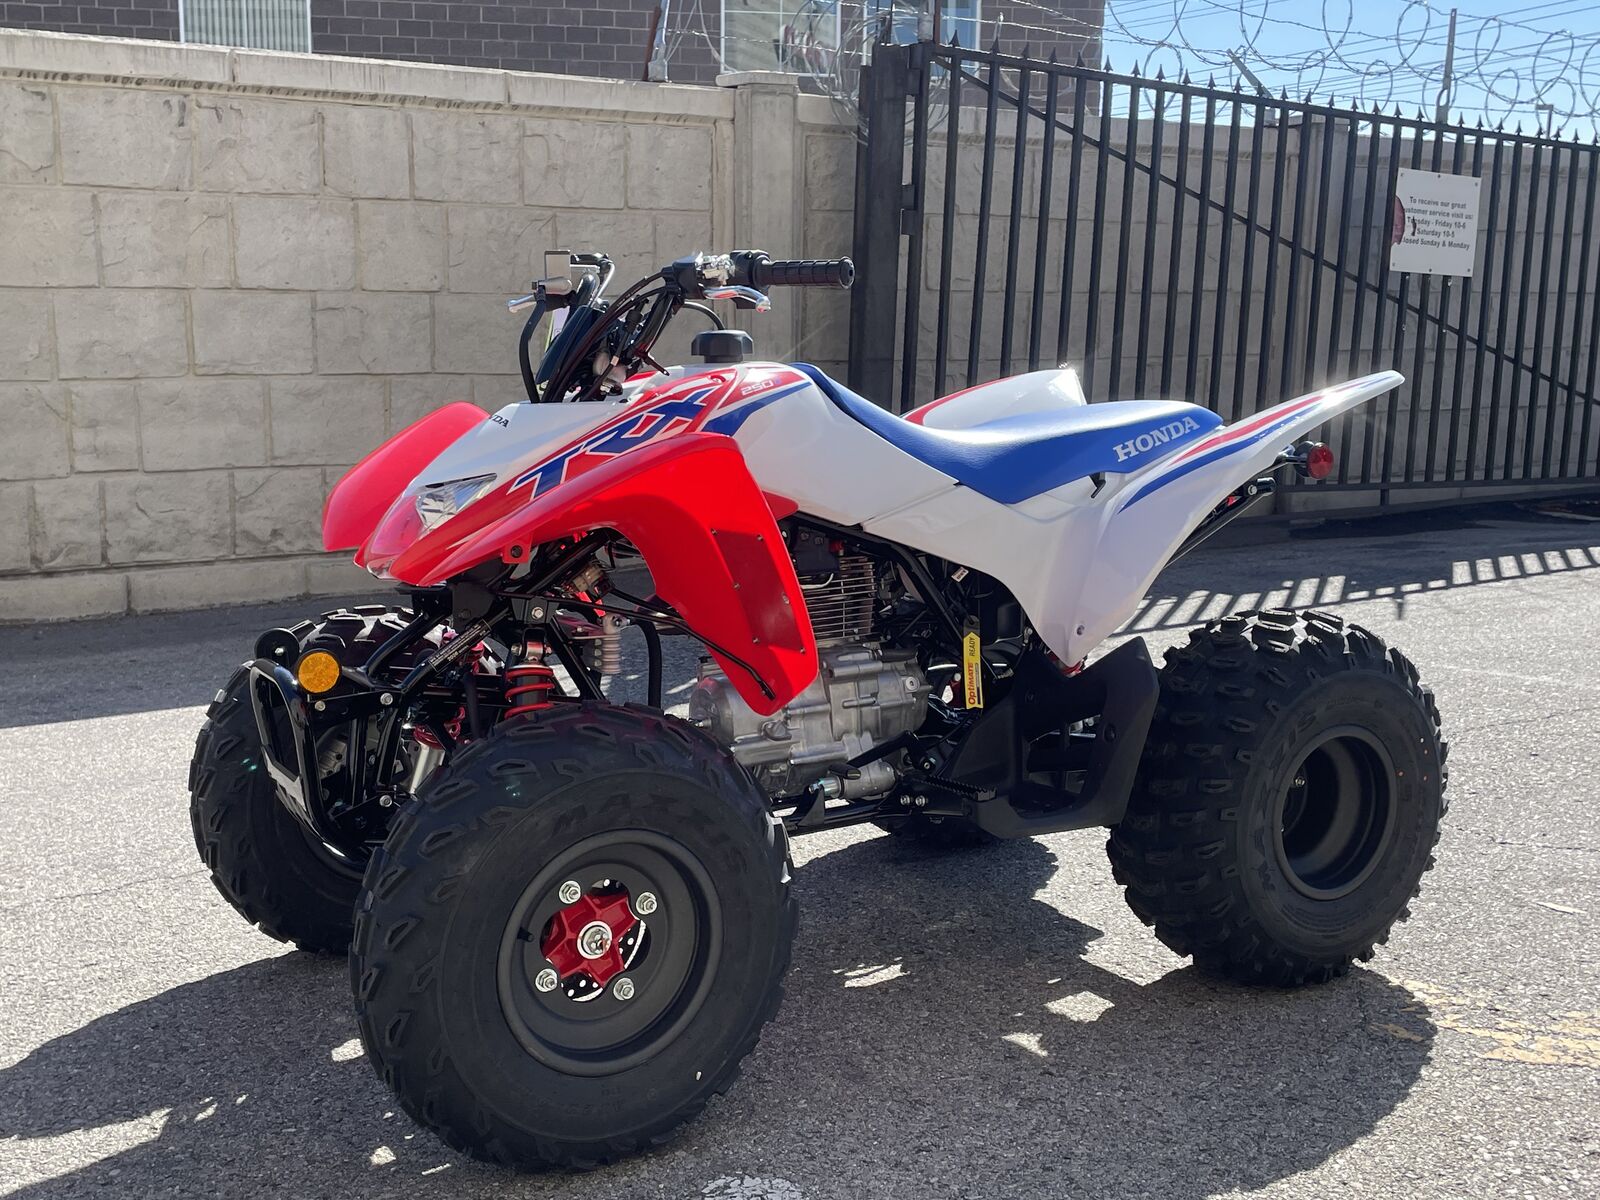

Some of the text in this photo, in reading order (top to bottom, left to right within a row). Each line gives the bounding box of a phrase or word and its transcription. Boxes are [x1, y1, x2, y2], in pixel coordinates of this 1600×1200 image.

[1410, 196, 1417, 204] To
[1418, 198, 1439, 206] receive
[1435, 219, 1453, 229] Friday
[1454, 221, 1466, 229] 10-6
[1417, 228, 1455, 238] Saturday 10-5
[1403, 236, 1419, 245] losed
[1420, 238, 1440, 249] Sunday
[1448, 241, 1470, 251] Monday
[507, 386, 719, 500] TRX
[1113, 416, 1200, 462] HONDA
[968, 637, 976, 657] READY
